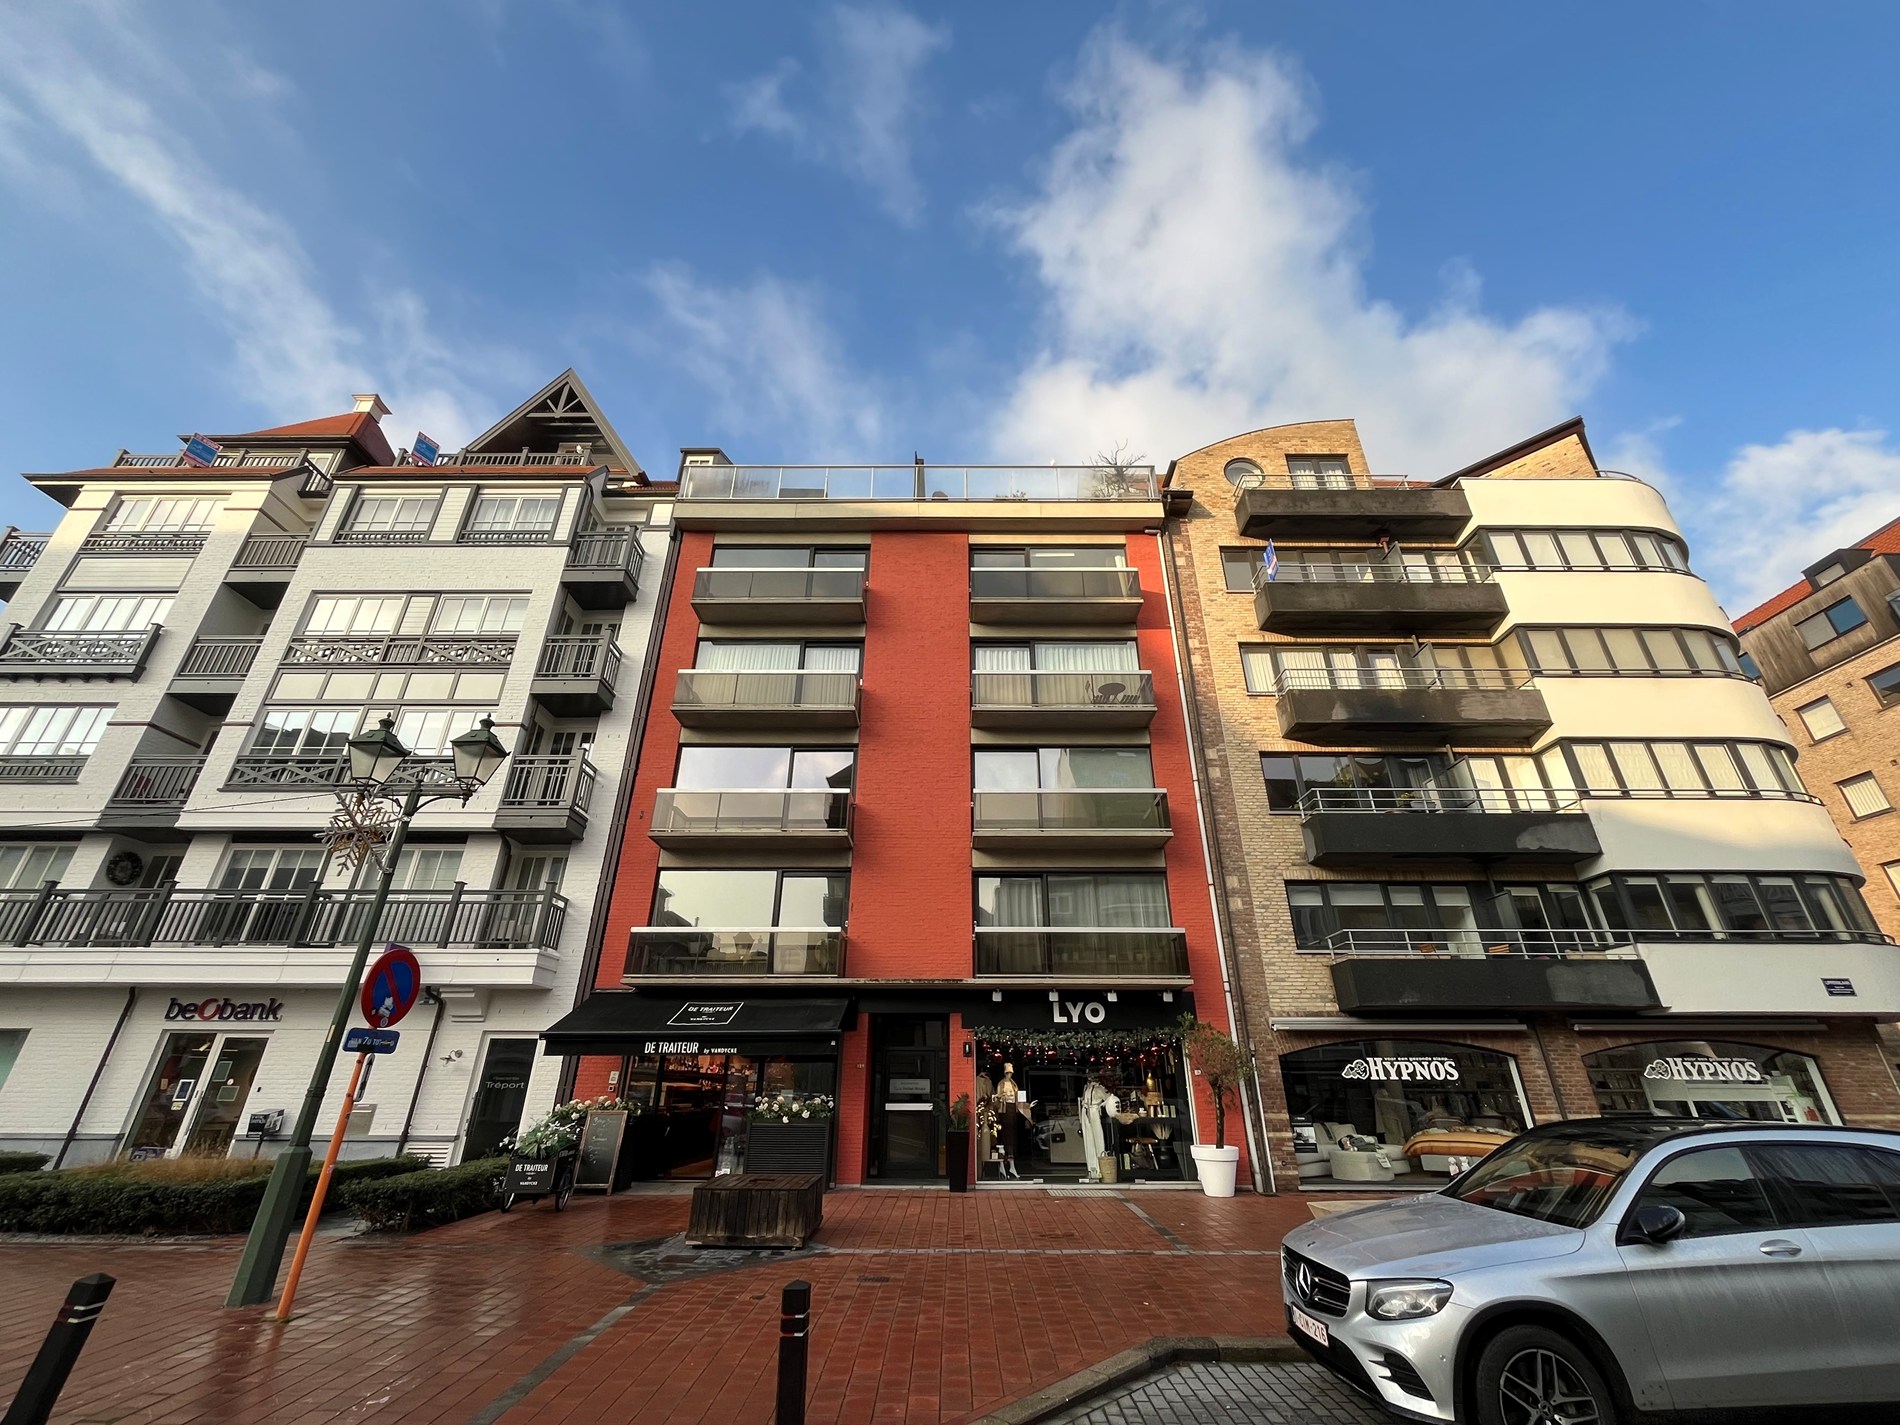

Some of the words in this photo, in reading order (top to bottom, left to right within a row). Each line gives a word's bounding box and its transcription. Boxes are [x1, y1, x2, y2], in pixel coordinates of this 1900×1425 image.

[1053, 1001, 1106, 1023] LYO
[645, 1042, 656, 1054] DE
[658, 1042, 699, 1054] TRAITEUR
[1366, 1057, 1459, 1081] HYPNOS
[1666, 1057, 1761, 1081] HYPNOS
[515, 1164, 523, 1172] DE
[524, 1164, 548, 1172] TRAITEUR
